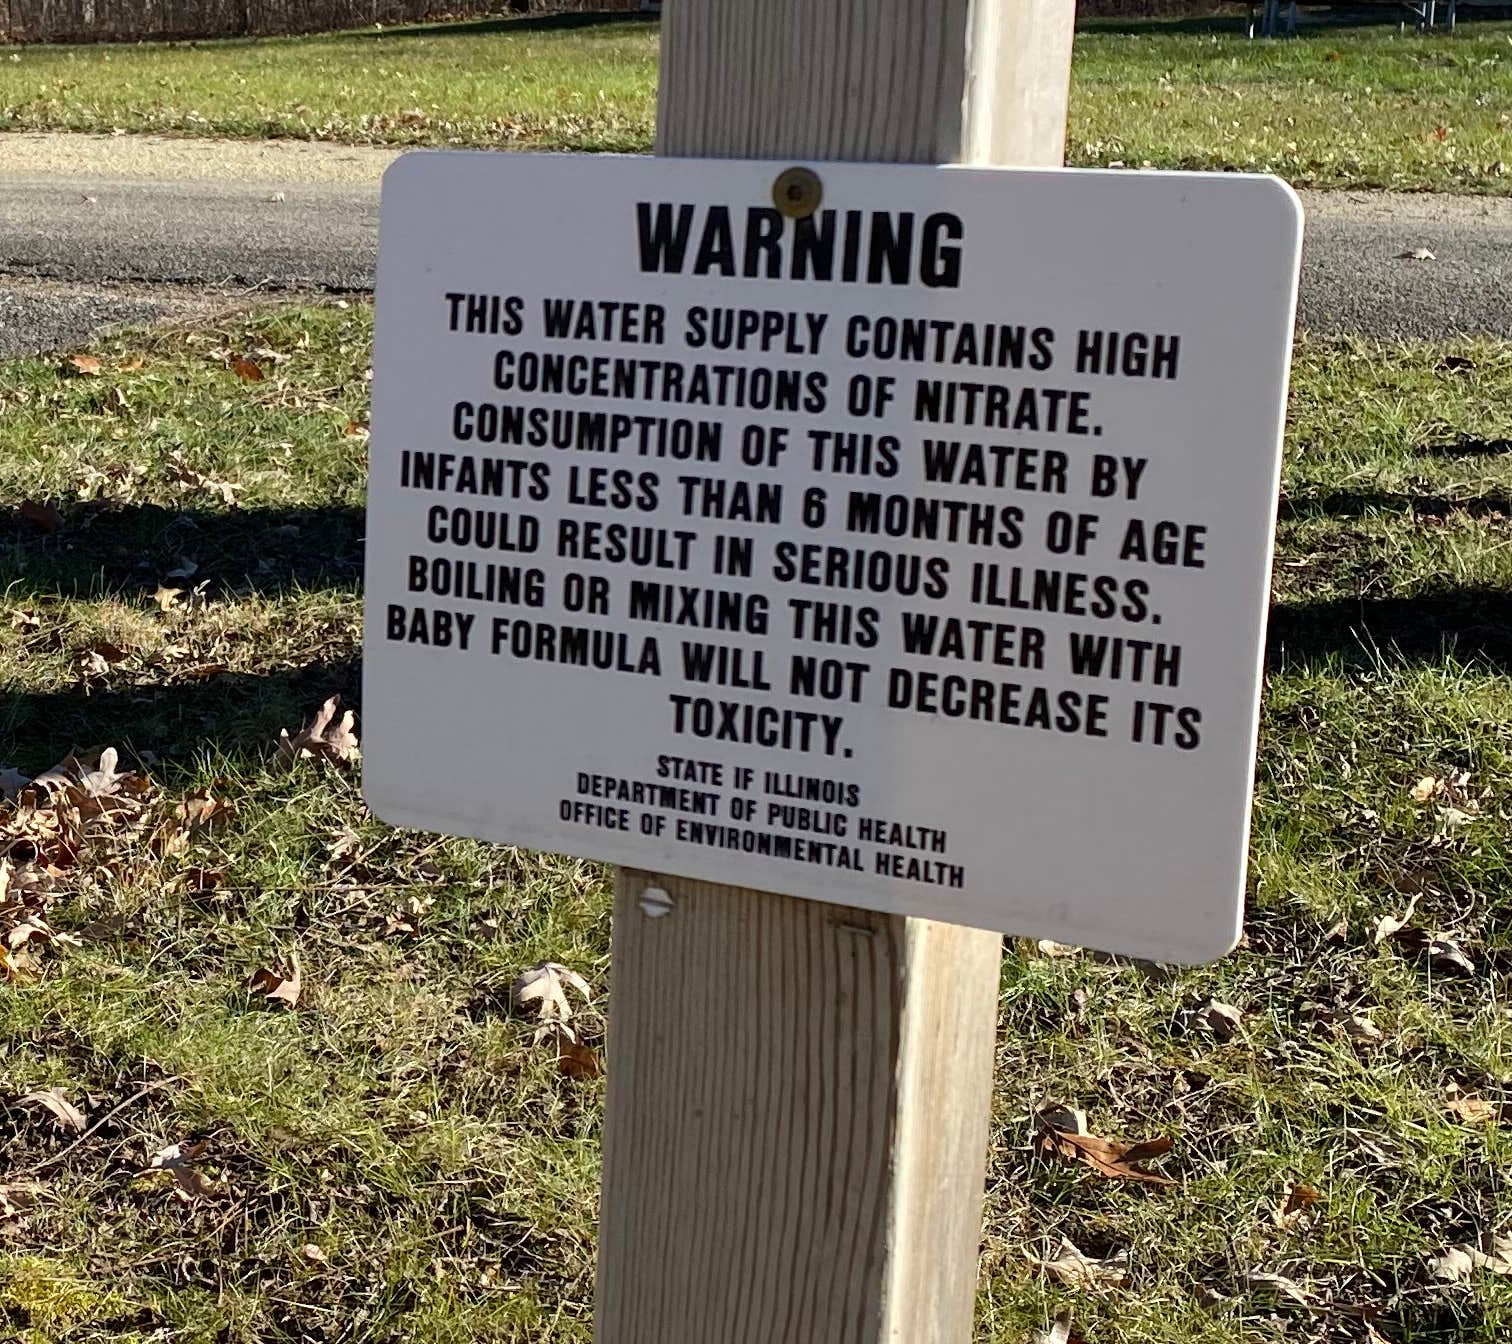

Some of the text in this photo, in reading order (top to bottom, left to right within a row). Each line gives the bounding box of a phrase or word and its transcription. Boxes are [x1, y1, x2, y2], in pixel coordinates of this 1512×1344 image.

[635, 201, 964, 289] WARNING
[445, 293, 1180, 379] THIS WATER SUPPLY CONTAINS HIGH
[494, 350, 1102, 436] CONCENTRATIONS OF NITRATE.
[453, 401, 1148, 500] CONSUMPTION OF THIS WATER BY
[401, 451, 1207, 568] INFANTS LESS THAN 6 MONTHS OF AGE
[428, 505, 1161, 624] COULD RESULT IN SERIOUS ILLNESS.
[408, 555, 1181, 687] BOILING OR MIXING THIS WATER WITH
[387, 604, 1201, 750] BABY FORMULA WILL NOT DECREASE ITS
[669, 694, 853, 758] TOXICITY.
[577, 772, 946, 853] DEPARTMENT OF PUBLIC HEALTH
[657, 755, 860, 807] STATE IF ILLINOIS
[560, 800, 964, 888] OFFICE OF ENVIRONMENTAL HEALTH
